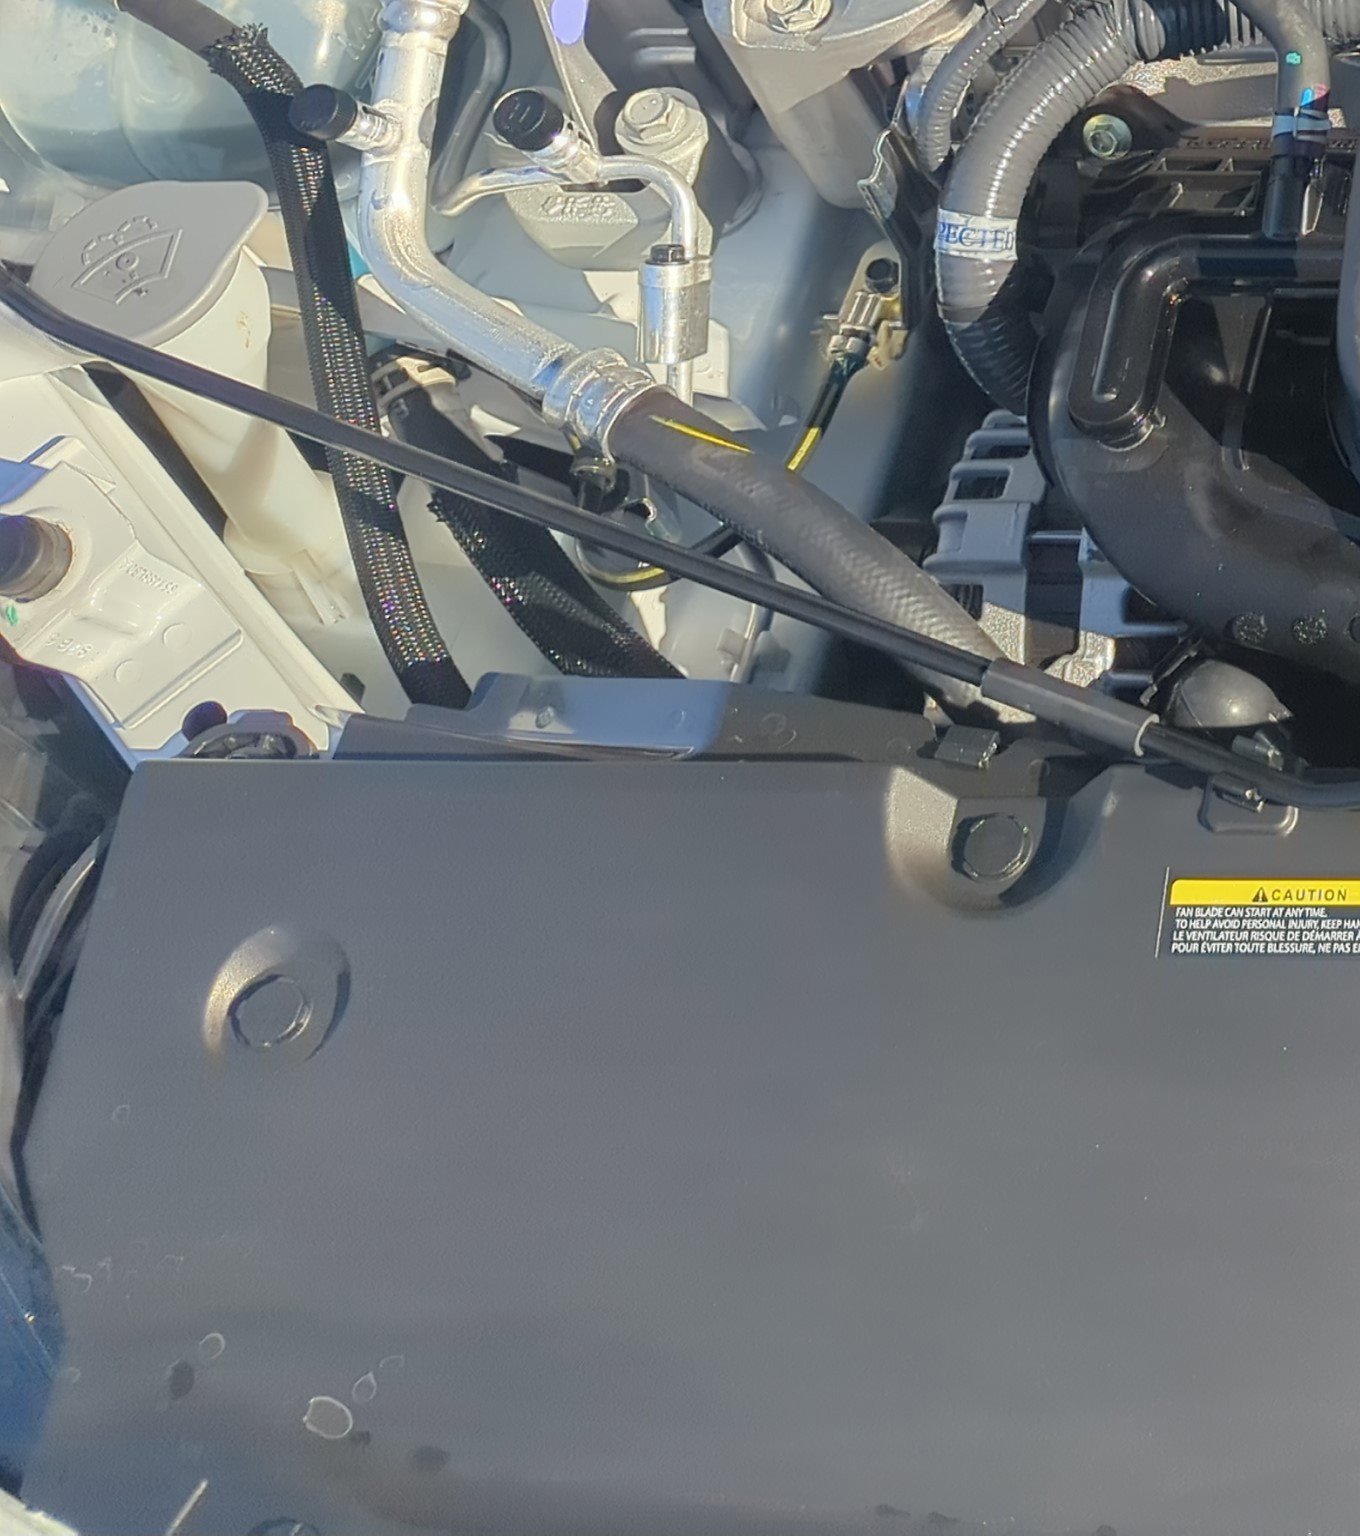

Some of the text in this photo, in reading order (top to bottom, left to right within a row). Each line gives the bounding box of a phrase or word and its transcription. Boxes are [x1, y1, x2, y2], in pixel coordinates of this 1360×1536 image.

[1271, 888, 1348, 902] CAUTION
[1175, 907, 1194, 918] FAN
[1195, 907, 1223, 918] BLADE
[1224, 907, 1245, 918] CAN
[1245, 907, 1273, 918] START
[1273, 907, 1284, 918] AT
[1284, 907, 1305, 918] ANY
[1175, 919, 1188, 930] TO
[1189, 919, 1212, 930] HELP
[1212, 919, 1240, 930] AVOID
[1241, 919, 1286, 930] PERSONAL
[1287, 919, 1320, 930] INJURY,
[1321, 919, 1342, 930] KEEP
[1173, 931, 1185, 941] LE
[1186, 931, 1249, 941] VENTILATEUR
[1250, 931, 1284, 941] RISQUE
[1285, 931, 1300, 941] DE
[1301, 929, 1355, 941] DÉMARRER
[1171, 943, 1199, 953] POUR
[1200, 941, 1233, 953] ÉVITER
[1234, 943, 1265, 953] TOUTE
[1266, 943, 1316, 953] BLESSURE,
[1317, 943, 1332, 953] NE
[1333, 943, 1350, 953] PAS
